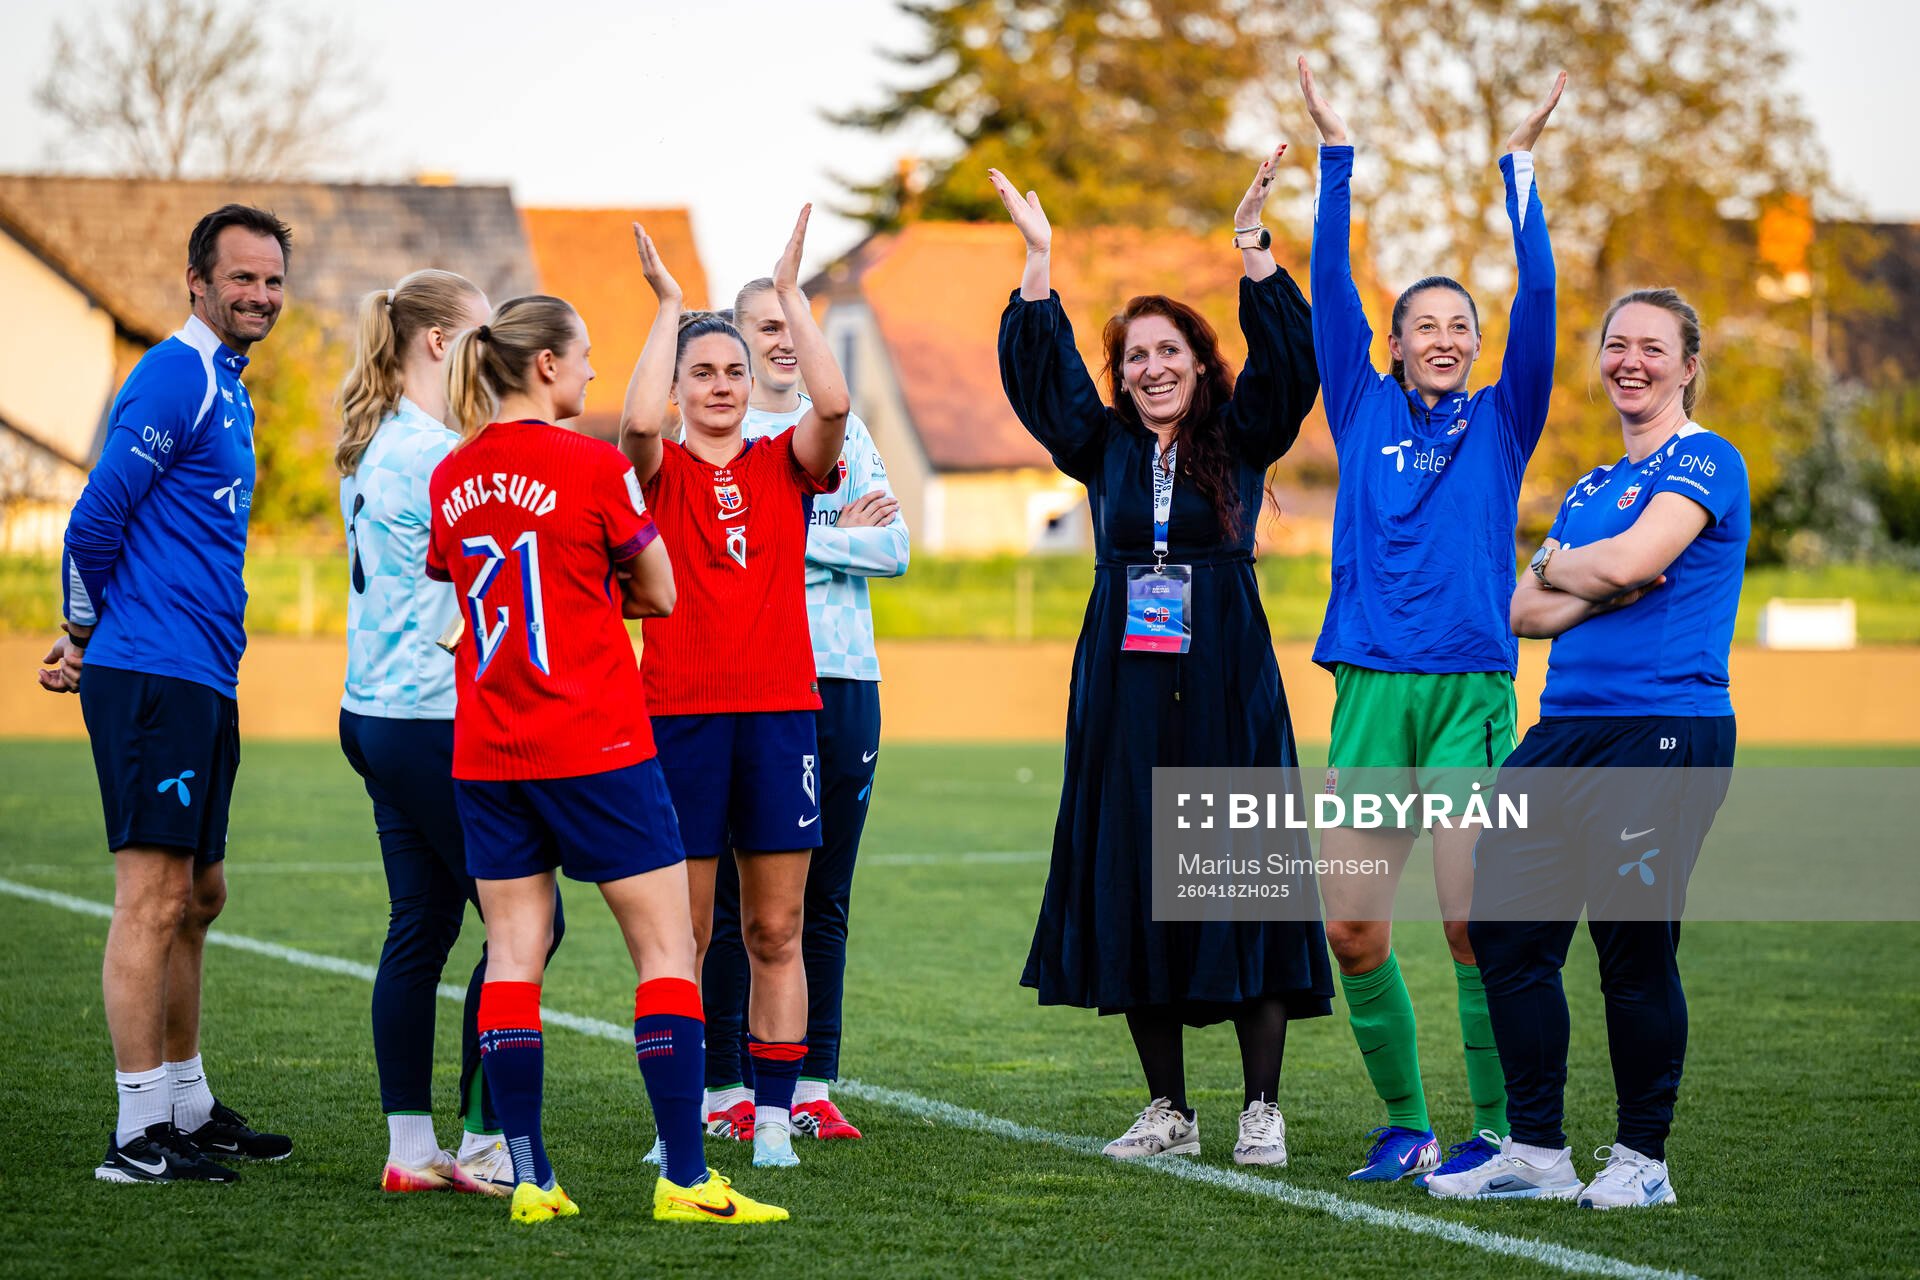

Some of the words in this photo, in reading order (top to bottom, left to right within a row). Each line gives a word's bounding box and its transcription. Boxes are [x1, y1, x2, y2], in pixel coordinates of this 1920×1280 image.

[142, 425, 174, 454] DNB
[1413, 448, 1452, 473] tele
[1679, 455, 1717, 477] DNB
[809, 508, 841, 526] eno
[726, 524, 747, 569] 8
[461, 531, 550, 682] 21
[1660, 737, 1677, 750] D3
[803, 755, 815, 807] 8
